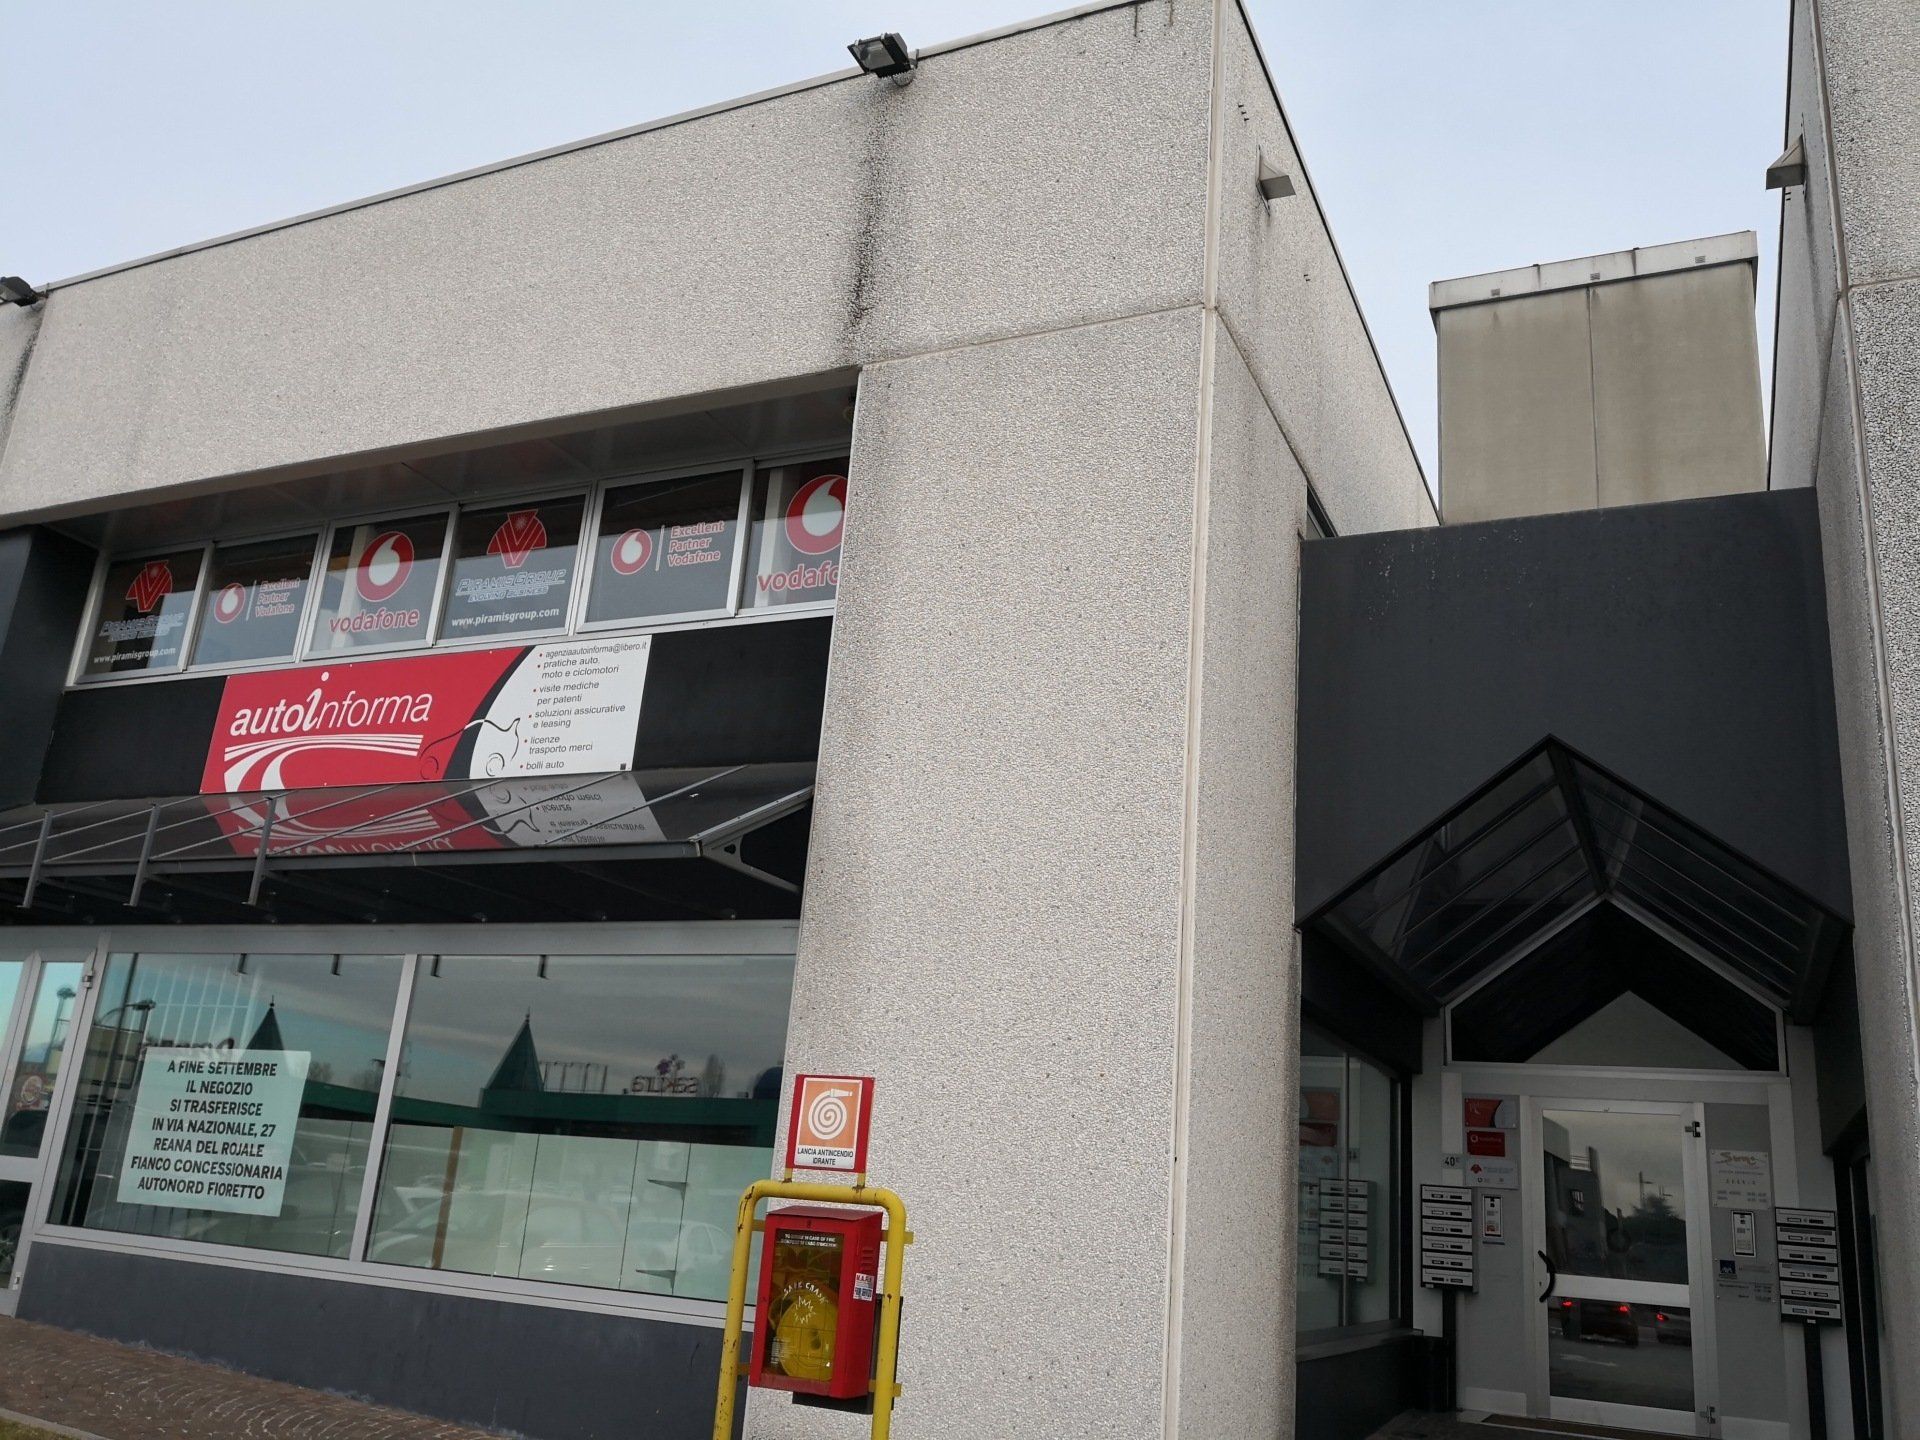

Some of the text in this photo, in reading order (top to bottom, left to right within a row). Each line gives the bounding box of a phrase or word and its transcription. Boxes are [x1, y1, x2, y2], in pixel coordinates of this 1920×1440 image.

[670, 520, 725, 538] Excellent
[668, 537, 712, 552] Partner
[667, 550, 721, 567] Vodafone
[757, 560, 840, 592] vodafo
[256, 591, 290, 605] Partner
[254, 603, 295, 618] Vodafone
[451, 608, 559, 626] www.piramisgroup.com
[328, 606, 420, 633] vodafone
[93, 647, 177, 663] www.piramisgroup.com
[545, 642, 647, 659] agenziaautoinforma@libero.it
[543, 657, 577, 670] pratiche
[541, 670, 562, 679] moto
[573, 665, 620, 677] ciclomotori
[539, 681, 599, 693] visite mediche
[230, 671, 434, 737] autoinforma
[537, 694, 582, 707] per patenti
[535, 704, 626, 718] soluzioni assicurative
[541, 719, 571, 729] leasing
[530, 735, 560, 744] licenze
[529, 742, 593, 756] trasporto merci
[526, 761, 564, 770] bolli auto
[168, 1060, 277, 1077] A FINE SETTEMBRE
[186, 1080, 253, 1095] IL NEGOZIO
[170, 1099, 263, 1116] SI TRASFERISCE
[152, 1118, 276, 1138] IN VIA NAZIONALE, 27
[153, 1138, 265, 1157] REANA DEL ROJALE
[797, 1147, 854, 1158] LANCIA ANTINCENDIO
[131, 1156, 283, 1180] FIANCO CONCESSIONARIA
[813, 1157, 836, 1165] IDRANTE
[138, 1176, 265, 1200] AUTONORD FIORETTO
